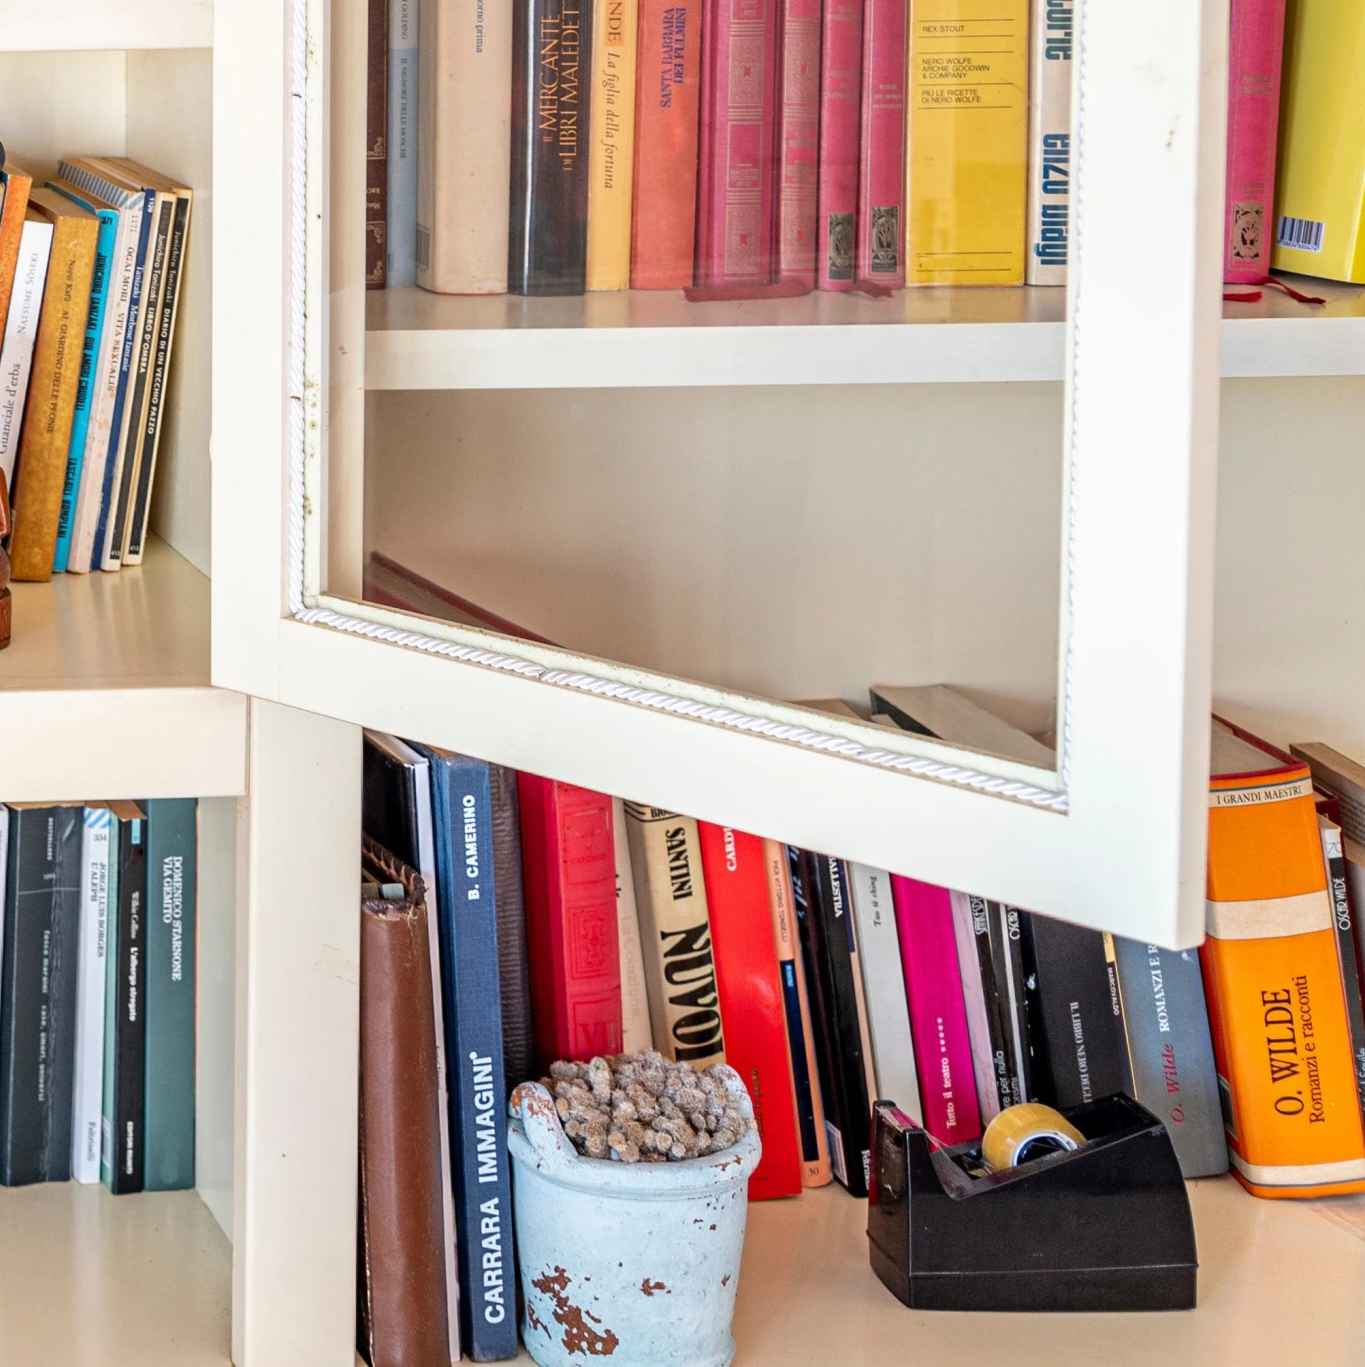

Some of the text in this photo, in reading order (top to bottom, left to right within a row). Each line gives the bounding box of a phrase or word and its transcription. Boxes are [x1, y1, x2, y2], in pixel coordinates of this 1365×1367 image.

[540, 14, 561, 131] MERCANTE
[560, 111, 577, 159] LIBRI
[464, 794, 480, 901] B. CAMERINO
[665, 827, 694, 900] SANTINI
[1262, 988, 1304, 1117] O. WILDE
[1296, 974, 1326, 1125] Romanzi e racconti
[482, 1197, 507, 1325] CARRARA
